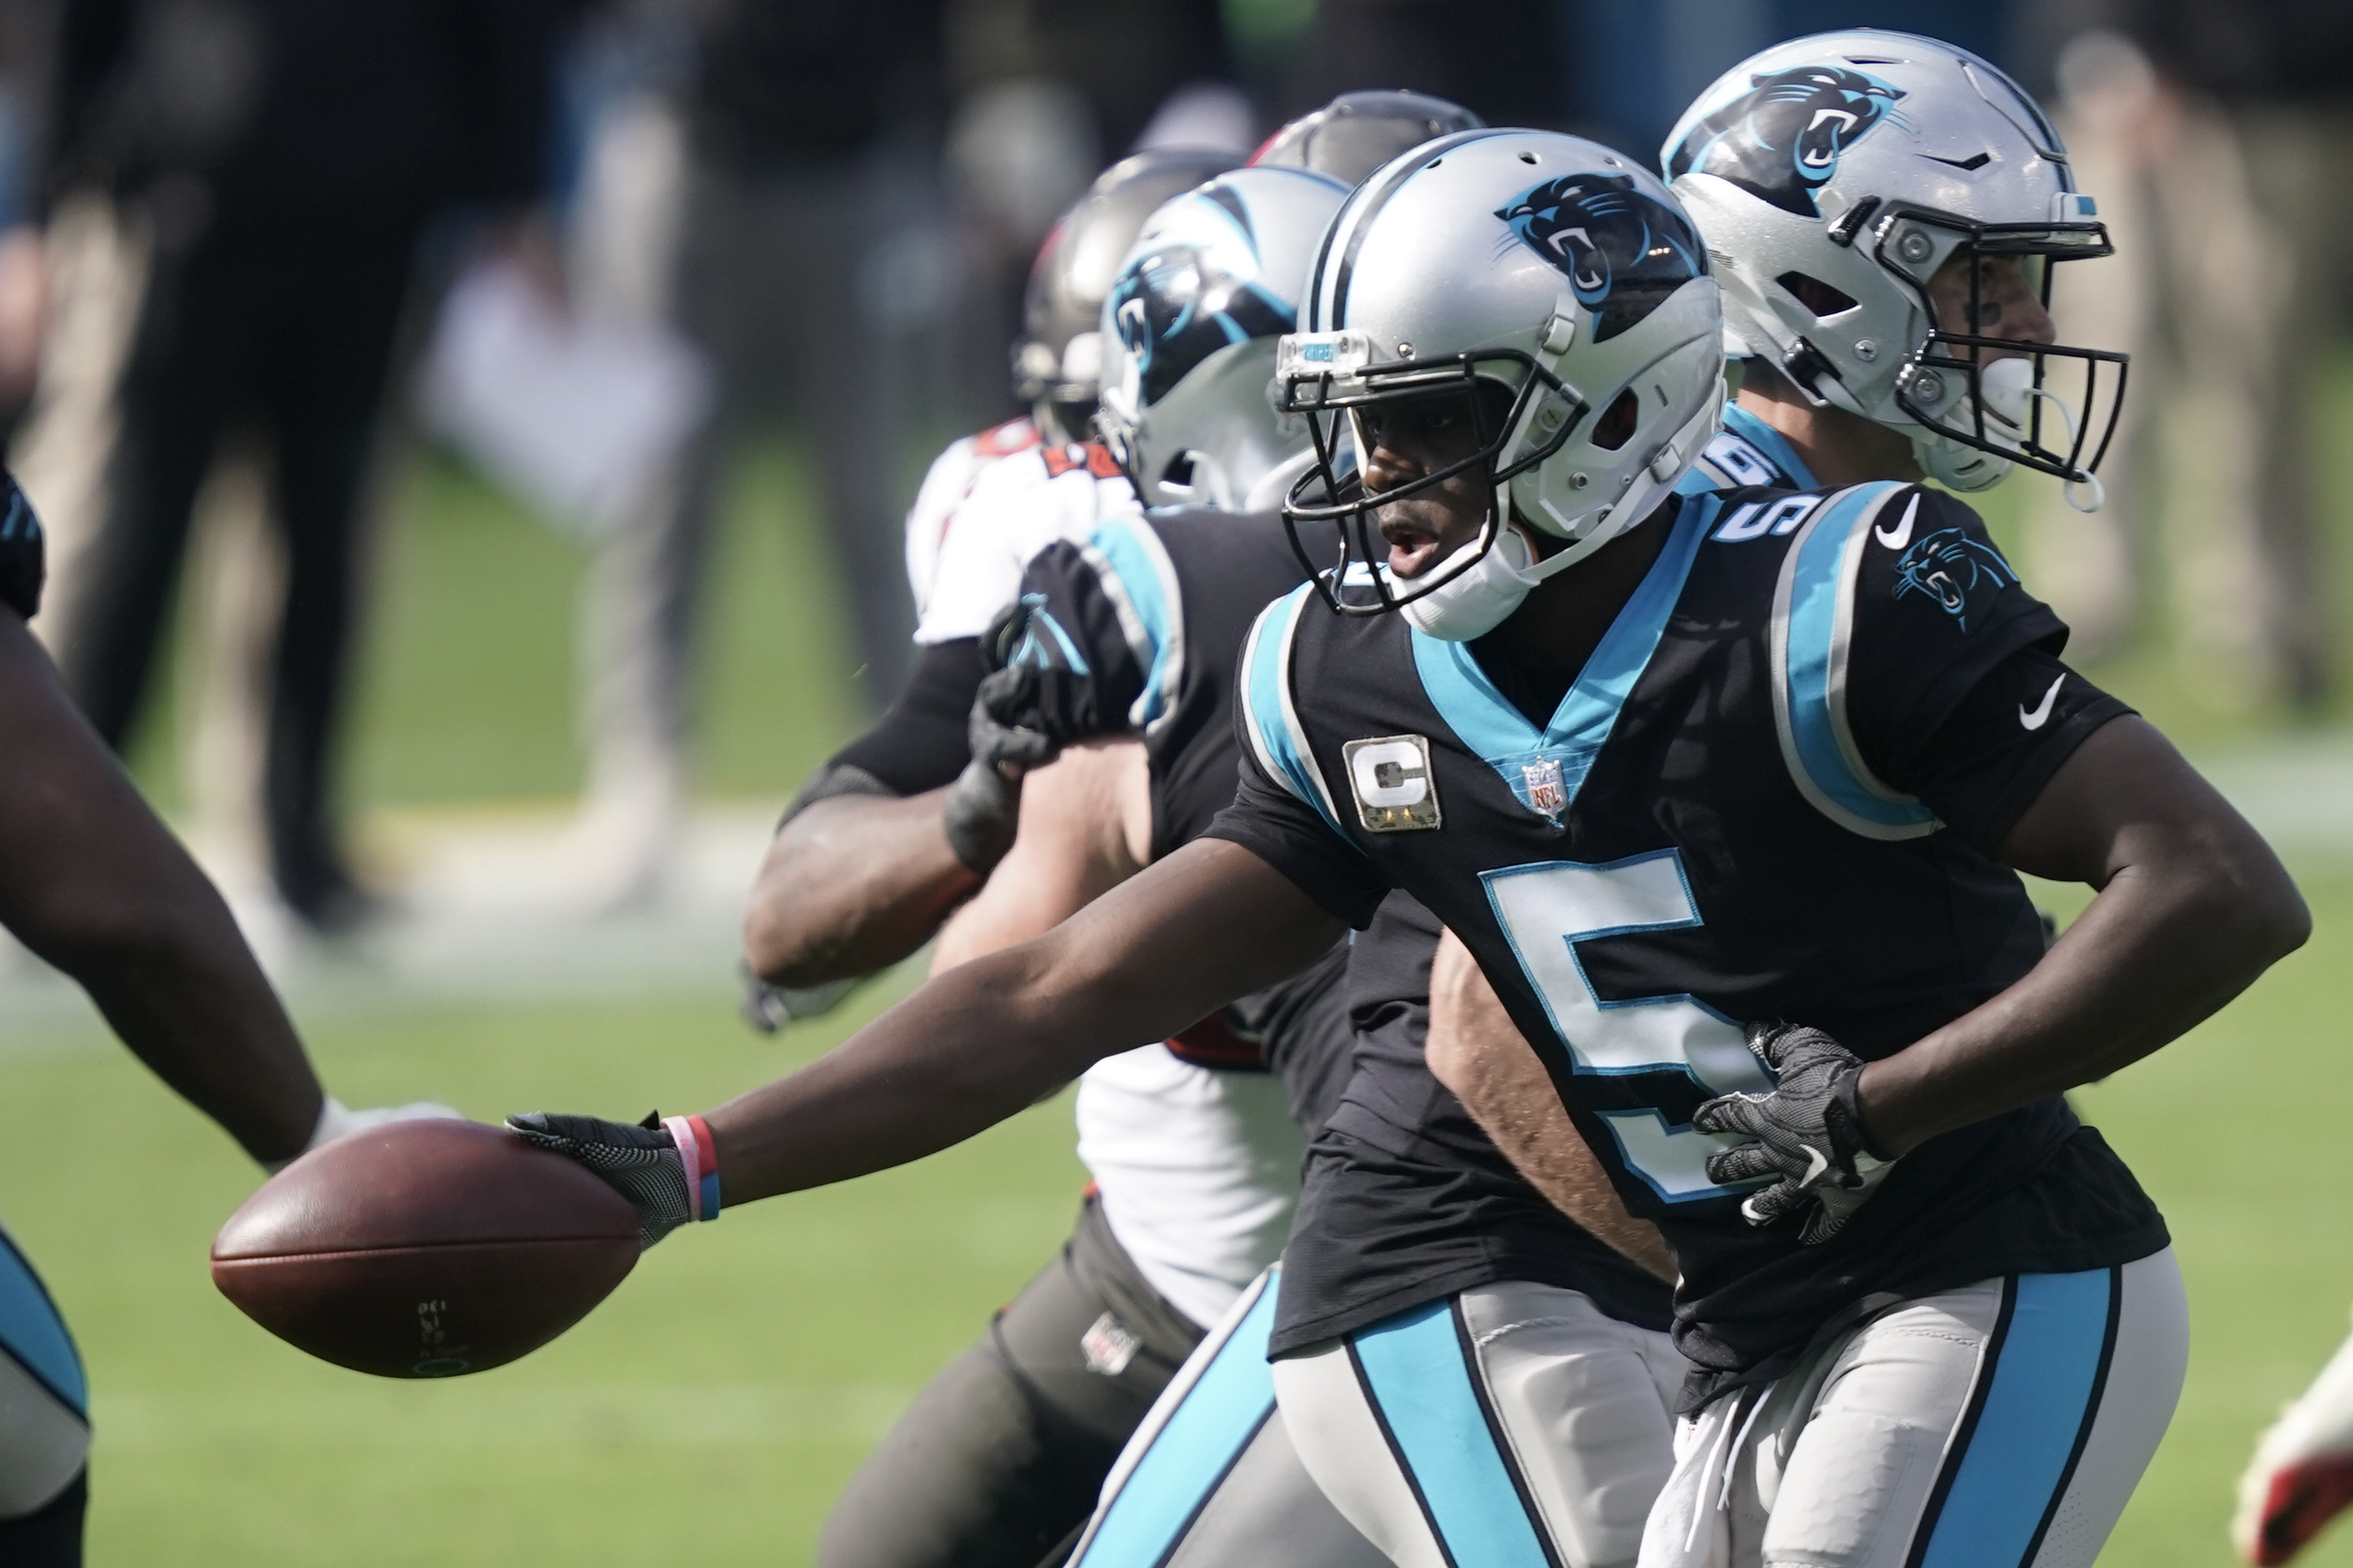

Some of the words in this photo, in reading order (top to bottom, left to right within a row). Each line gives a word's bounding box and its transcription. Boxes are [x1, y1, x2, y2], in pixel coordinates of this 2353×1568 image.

[1352, 741, 1428, 809] C
[1531, 785, 1561, 809] NFL
[1477, 845, 1782, 1204] 5
